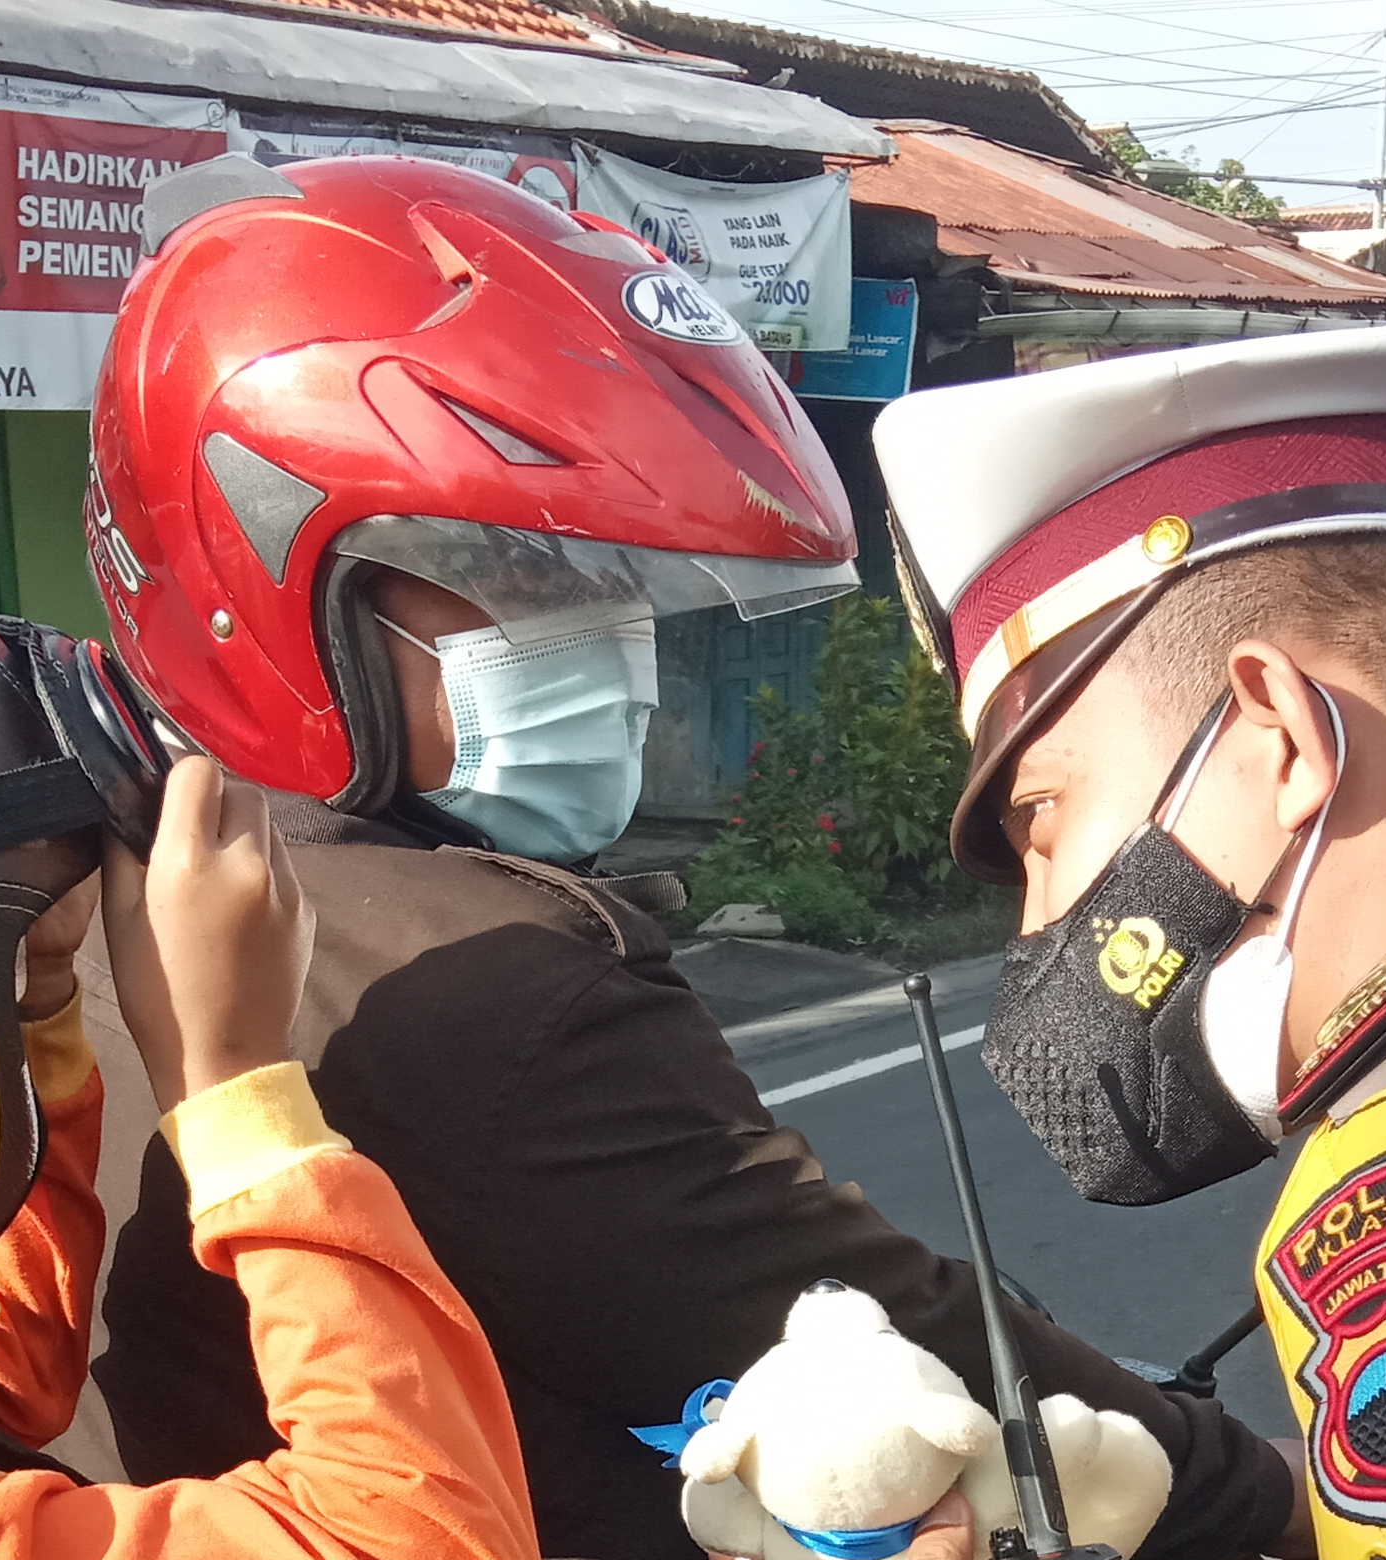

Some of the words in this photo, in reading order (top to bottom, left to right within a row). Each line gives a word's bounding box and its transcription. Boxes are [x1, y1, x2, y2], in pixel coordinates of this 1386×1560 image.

[678, 214, 704, 265] MILD
[723, 216, 752, 231] YANG
[752, 212, 782, 229] LAIN
[17, 240, 137, 279] PEMEN
[729, 235, 756, 250] PADA
[759, 233, 791, 248] NAIK
[739, 264, 759, 279] GUE
[759, 262, 790, 278] TETA
[687, 323, 727, 338] HELMET
[88, 445, 155, 597] DS
[1133, 949, 1185, 1009] POLRI
[1324, 1268, 1377, 1316] JAWA
